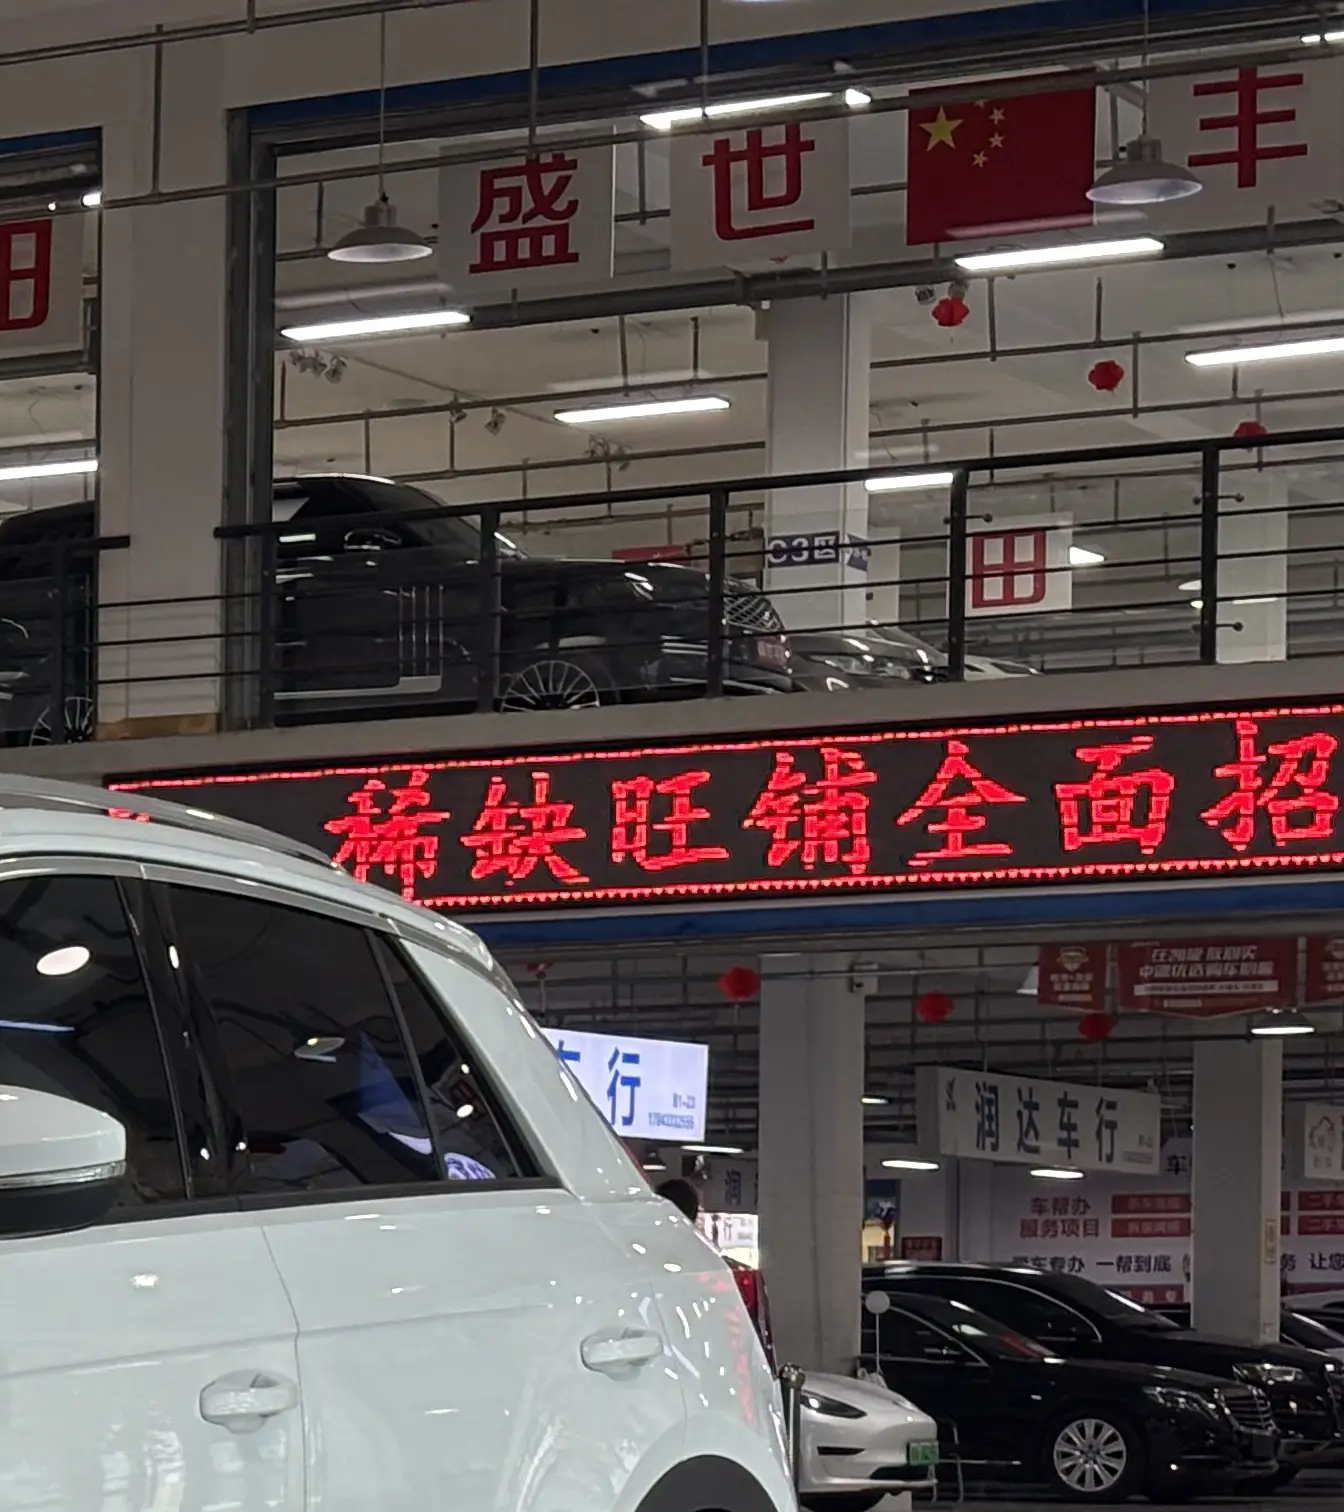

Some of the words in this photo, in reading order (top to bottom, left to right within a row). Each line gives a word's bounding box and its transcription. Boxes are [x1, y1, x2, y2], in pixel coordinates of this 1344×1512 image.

[469, 152, 579, 274] 盛
[703, 123, 815, 241] 世
[1188, 67, 1308, 189] 丰
[971, 528, 1047, 609] 田
[324, 719, 1340, 901] 稀缺旺铺全面招
[974, 1082, 1119, 1164] 润达车行
[1018, 1218, 1100, 1239] 服务项目
[1095, 1253, 1172, 1274] 一帮到底
